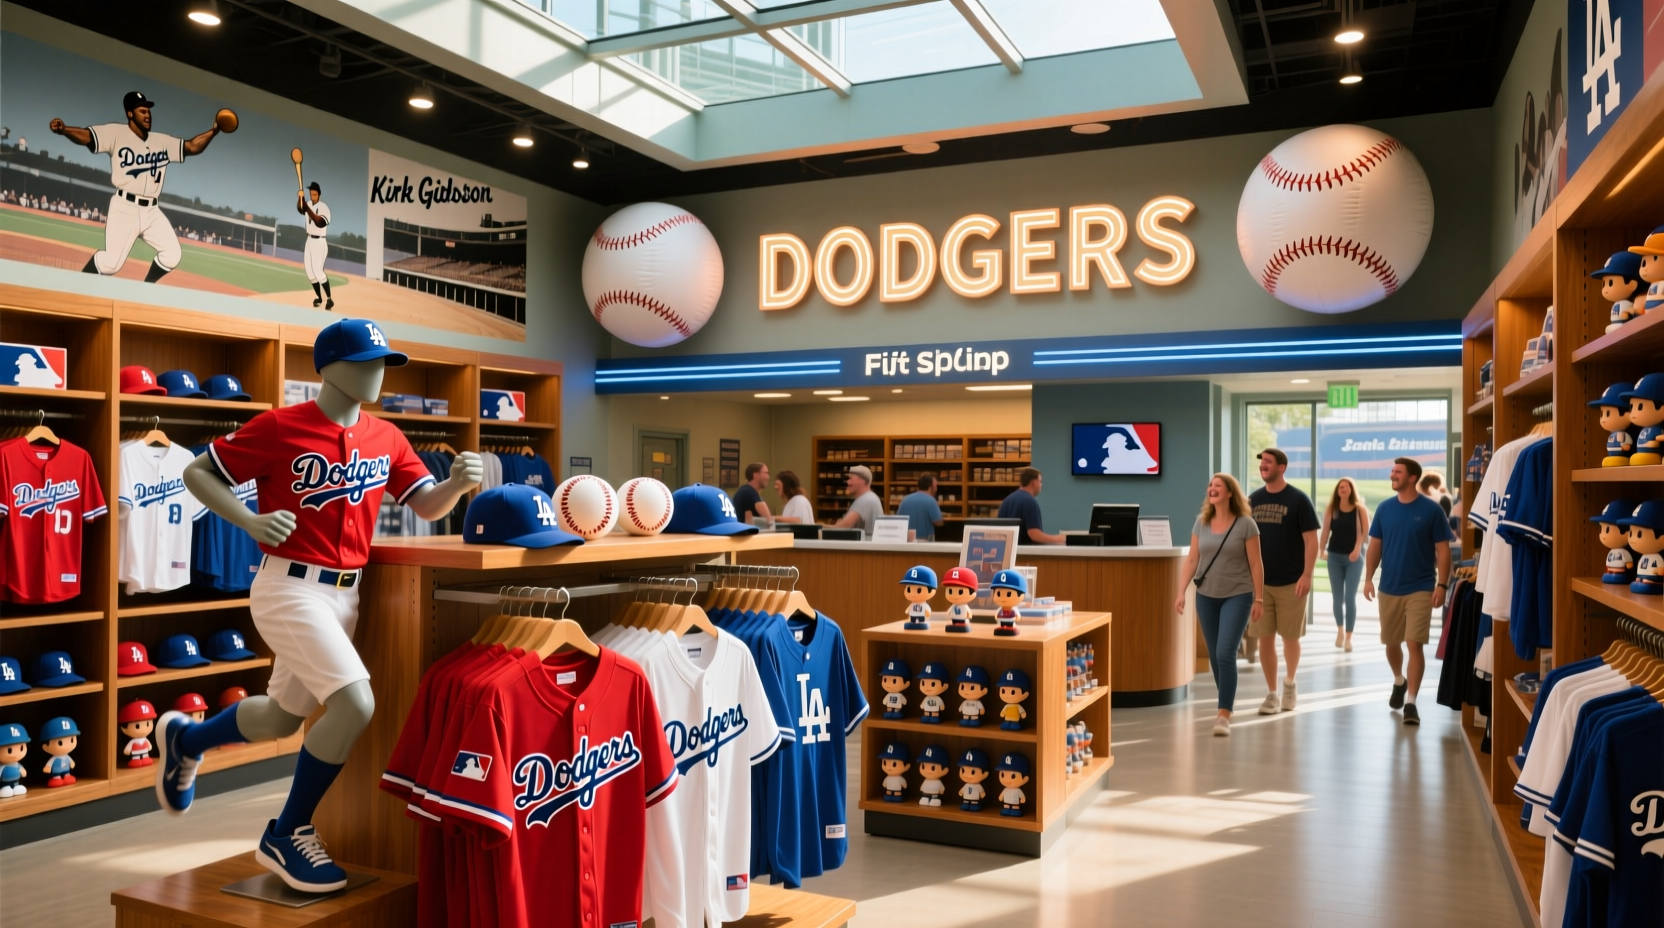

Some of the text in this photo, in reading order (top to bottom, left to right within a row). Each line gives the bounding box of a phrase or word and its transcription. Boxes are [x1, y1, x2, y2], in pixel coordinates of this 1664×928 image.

[370, 175, 414, 204] Kirk
[759, 195, 1196, 311] DODGERS
[365, 324, 387, 347] LA
[533, 495, 558, 526] LA
[718, 494, 737, 518] LA
[796, 673, 831, 745] LA
[664, 703, 746, 768] Dodgers
[514, 731, 640, 811] Dodgers
